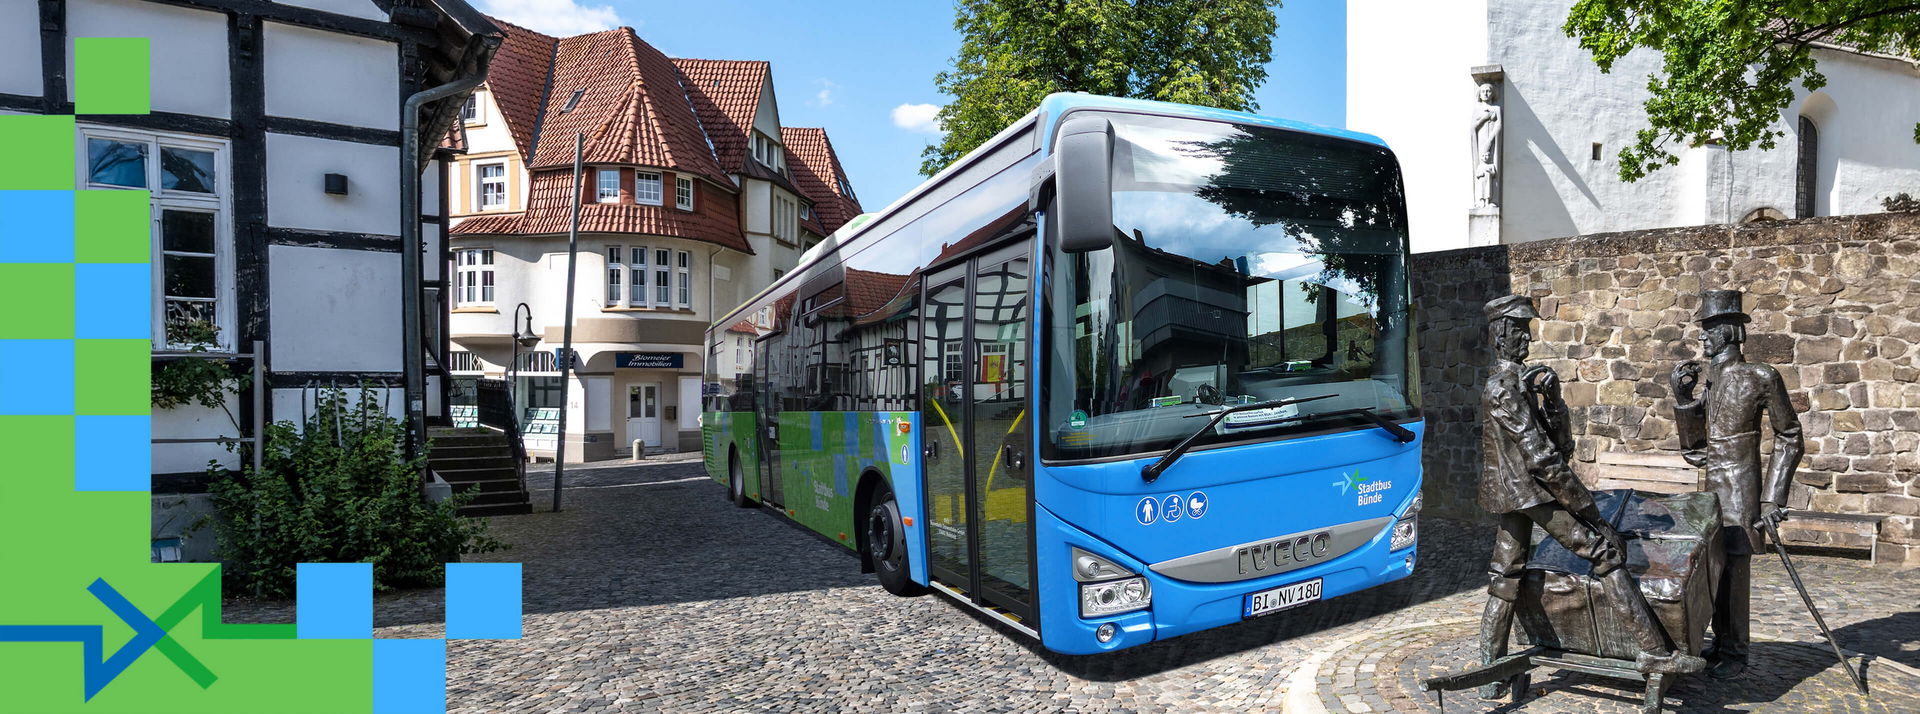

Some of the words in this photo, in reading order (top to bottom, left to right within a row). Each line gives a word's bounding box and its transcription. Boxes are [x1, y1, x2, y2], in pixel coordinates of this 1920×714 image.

[570, 401, 579, 409] 14
[1075, 412, 1081, 420] 4
[1357, 479, 1392, 495] Stadtbus
[1357, 491, 1383, 507] Bünde
[1238, 531, 1331, 575] IVECO
[1253, 593, 1269, 612] BI
[1278, 586, 1296, 606] NV
[1296, 581, 1320, 602] 180
